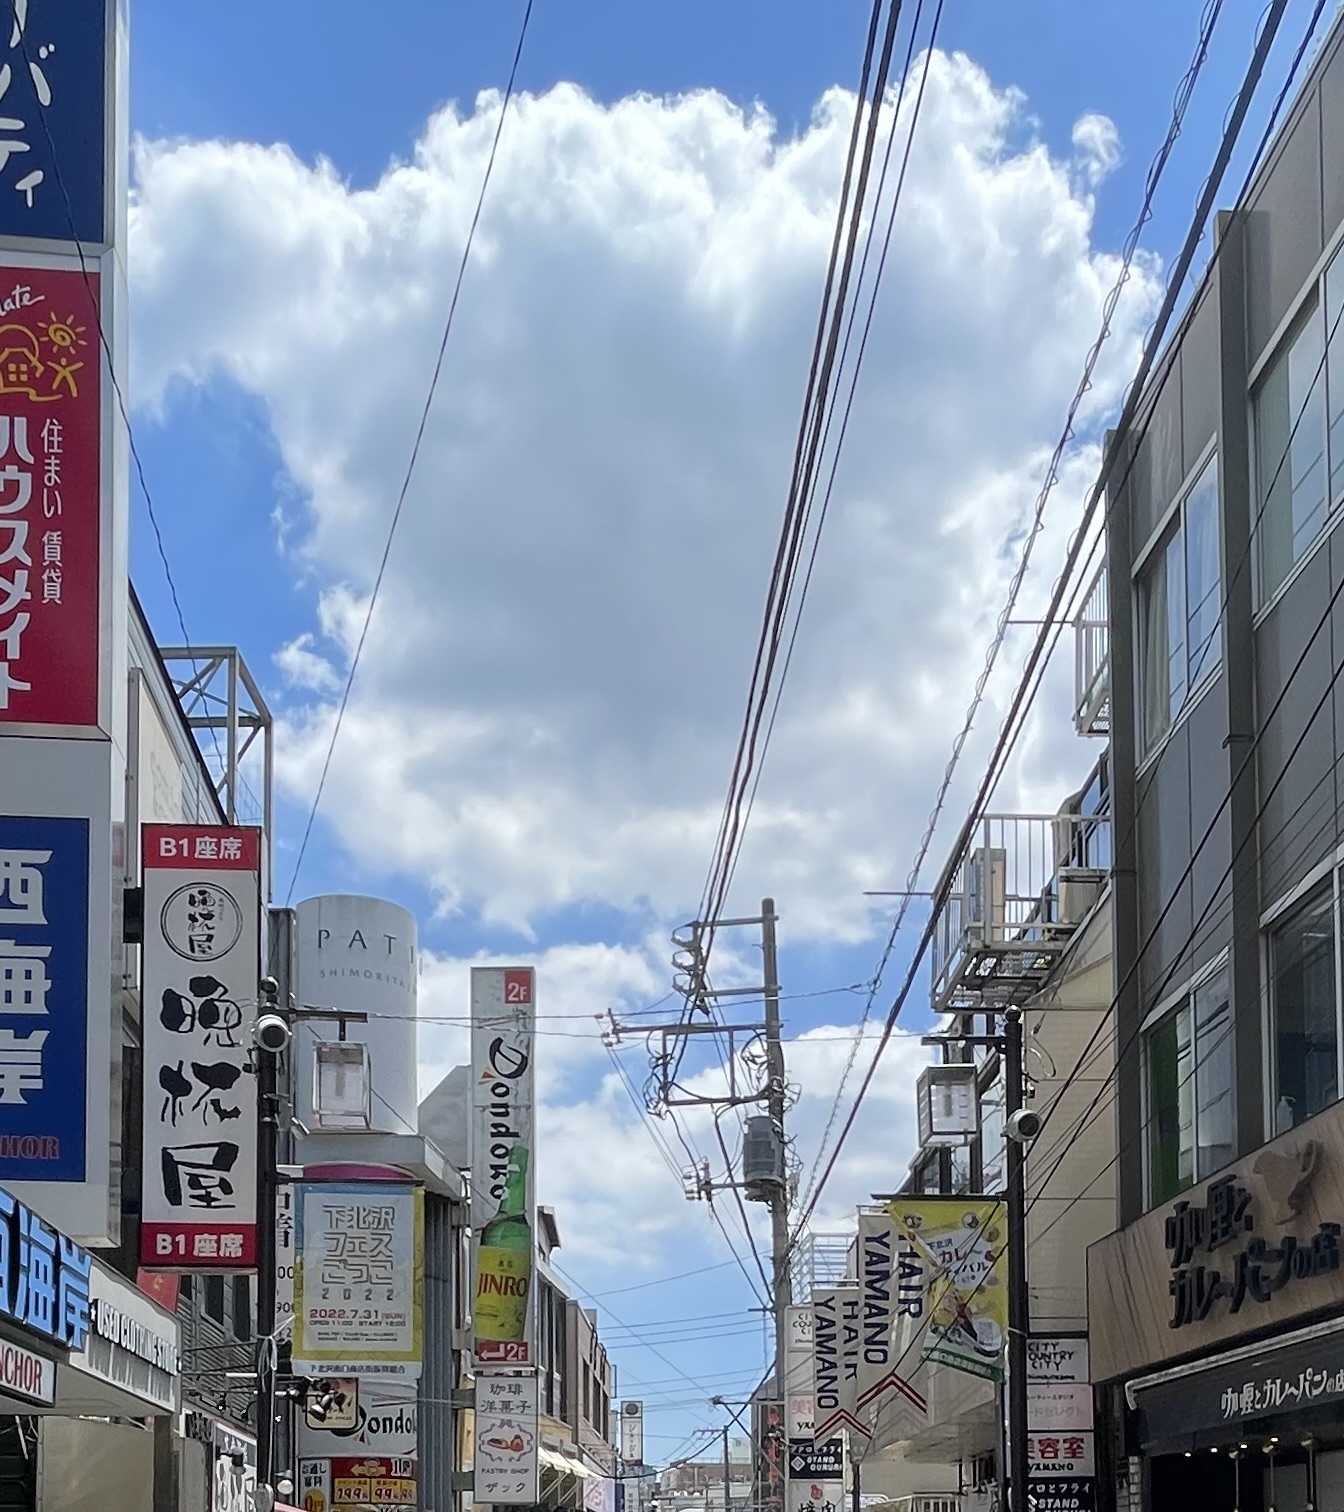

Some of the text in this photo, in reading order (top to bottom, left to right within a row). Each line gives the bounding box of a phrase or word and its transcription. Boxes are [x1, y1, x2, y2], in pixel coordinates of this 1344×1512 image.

[41, 418, 64, 604] 住まい 賃貸
[158, 836, 243, 861] B1座席
[508, 981, 527, 1001] 2F
[323, 1204, 395, 1230] 下北沢
[156, 1232, 243, 1258] B1座席
[323, 1231, 394, 1258] フェス
[322, 1258, 394, 1285] ごっこ
[476, 1272, 527, 1298] JINRO
[864, 1230, 891, 1365] YAMANO
[97, 1298, 120, 1344] USED
[309, 1308, 379, 1320] 2022.7.31
[506, 1343, 527, 1361] 2F
[814, 1296, 839, 1409] YAMANO
[1028, 1342, 1060, 1352] CITY
[1028, 1351, 1074, 1361] OUNTRY
[1031, 1361, 1062, 1372] CITY
[490, 1383, 523, 1396] 珈琲
[480, 1400, 531, 1414] 洋菓子
[485, 1481, 527, 1494] ザック
[1038, 1498, 1079, 1509] STAND
